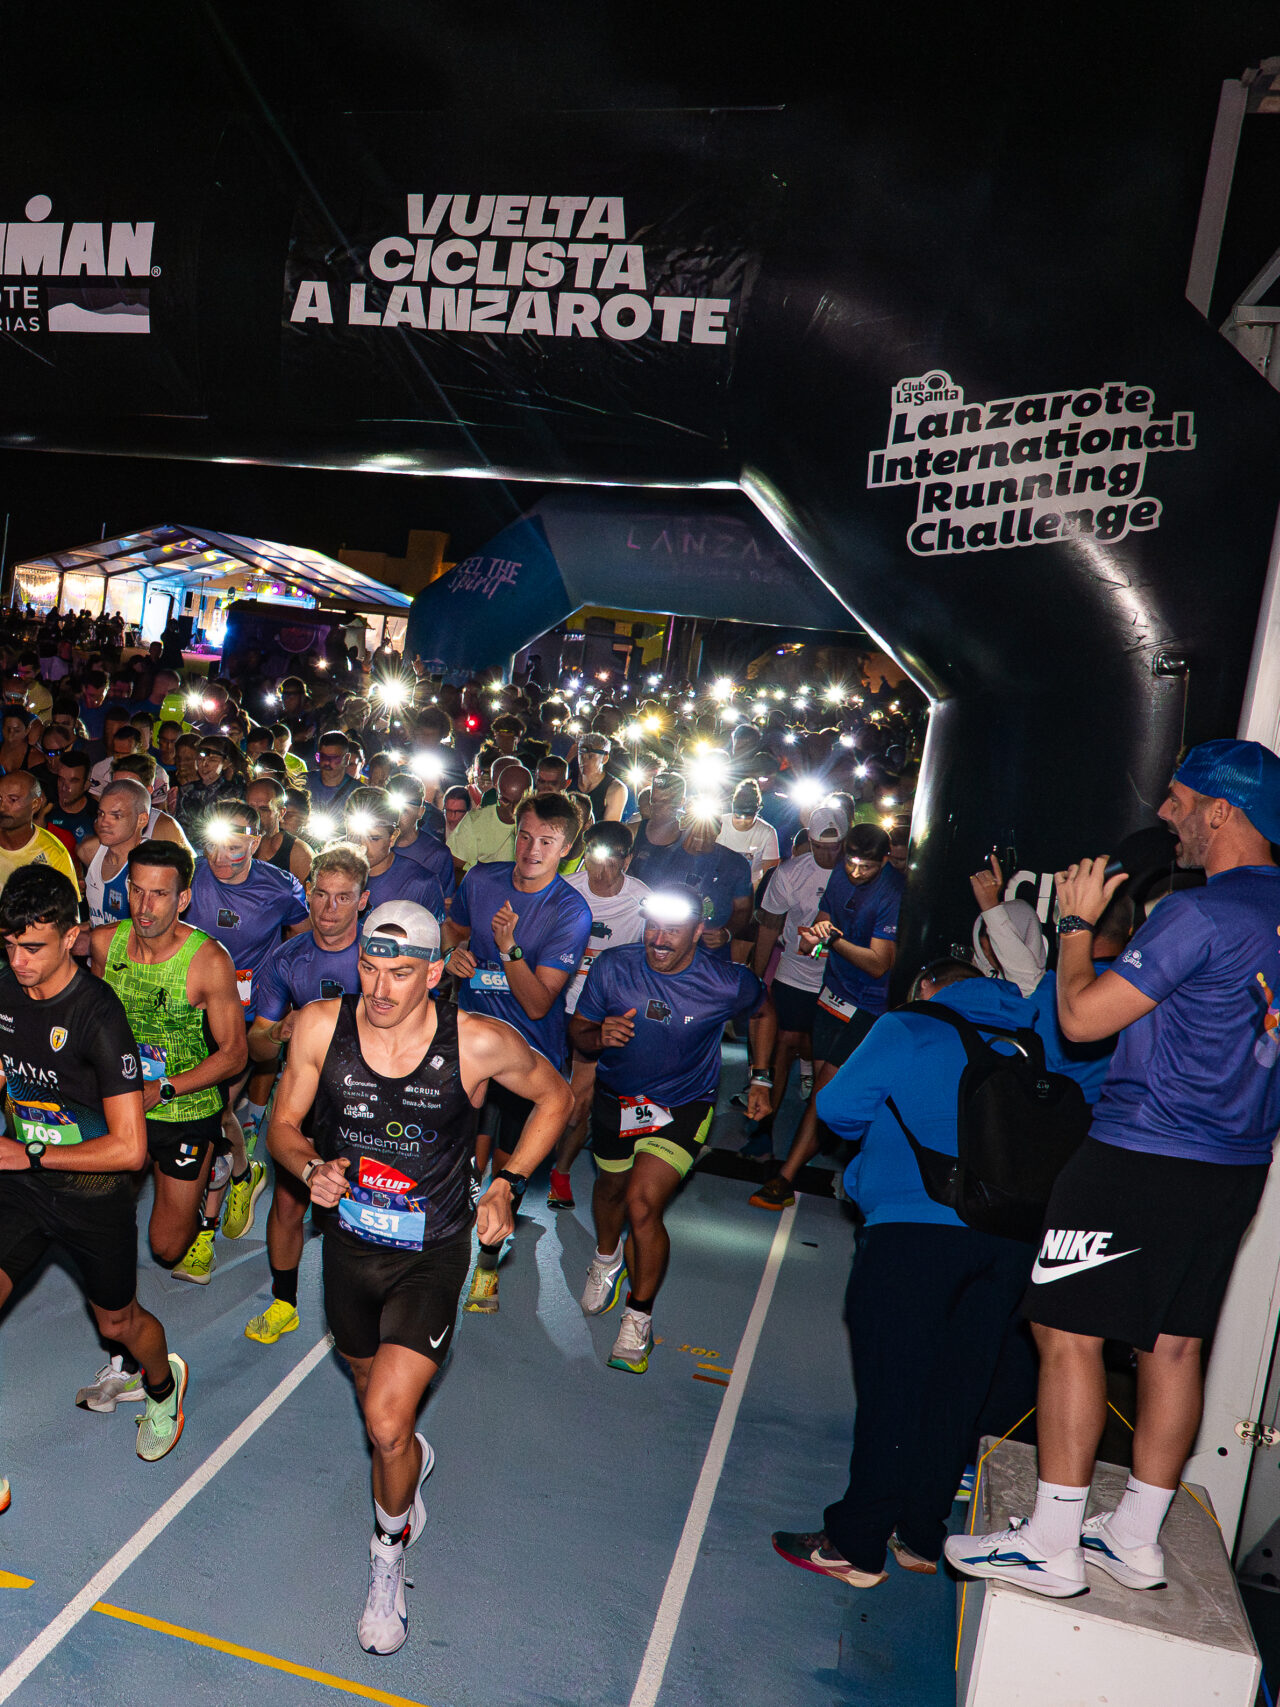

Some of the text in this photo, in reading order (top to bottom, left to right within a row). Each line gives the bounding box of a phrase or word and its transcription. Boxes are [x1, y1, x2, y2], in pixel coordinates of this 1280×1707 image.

[405, 192, 626, 240] VUELTA
[369, 236, 647, 291] CICLISTA
[289, 280, 732, 345] A LANZAROTE
[901, 381, 925, 392] Club
[891, 384, 1152, 445] Lanzarote
[870, 415, 1192, 485] International
[921, 460, 1141, 514] Running
[910, 499, 1159, 554] Challenge
[488, 557, 523, 584] THE
[635, 1105, 653, 1120] 94
[21, 1123, 62, 1144] 709
[339, 1126, 420, 1152] Veldeman
[362, 1173, 411, 1190] WCUP
[360, 1208, 400, 1233] 531
[1039, 1229, 1114, 1260] NIKE
